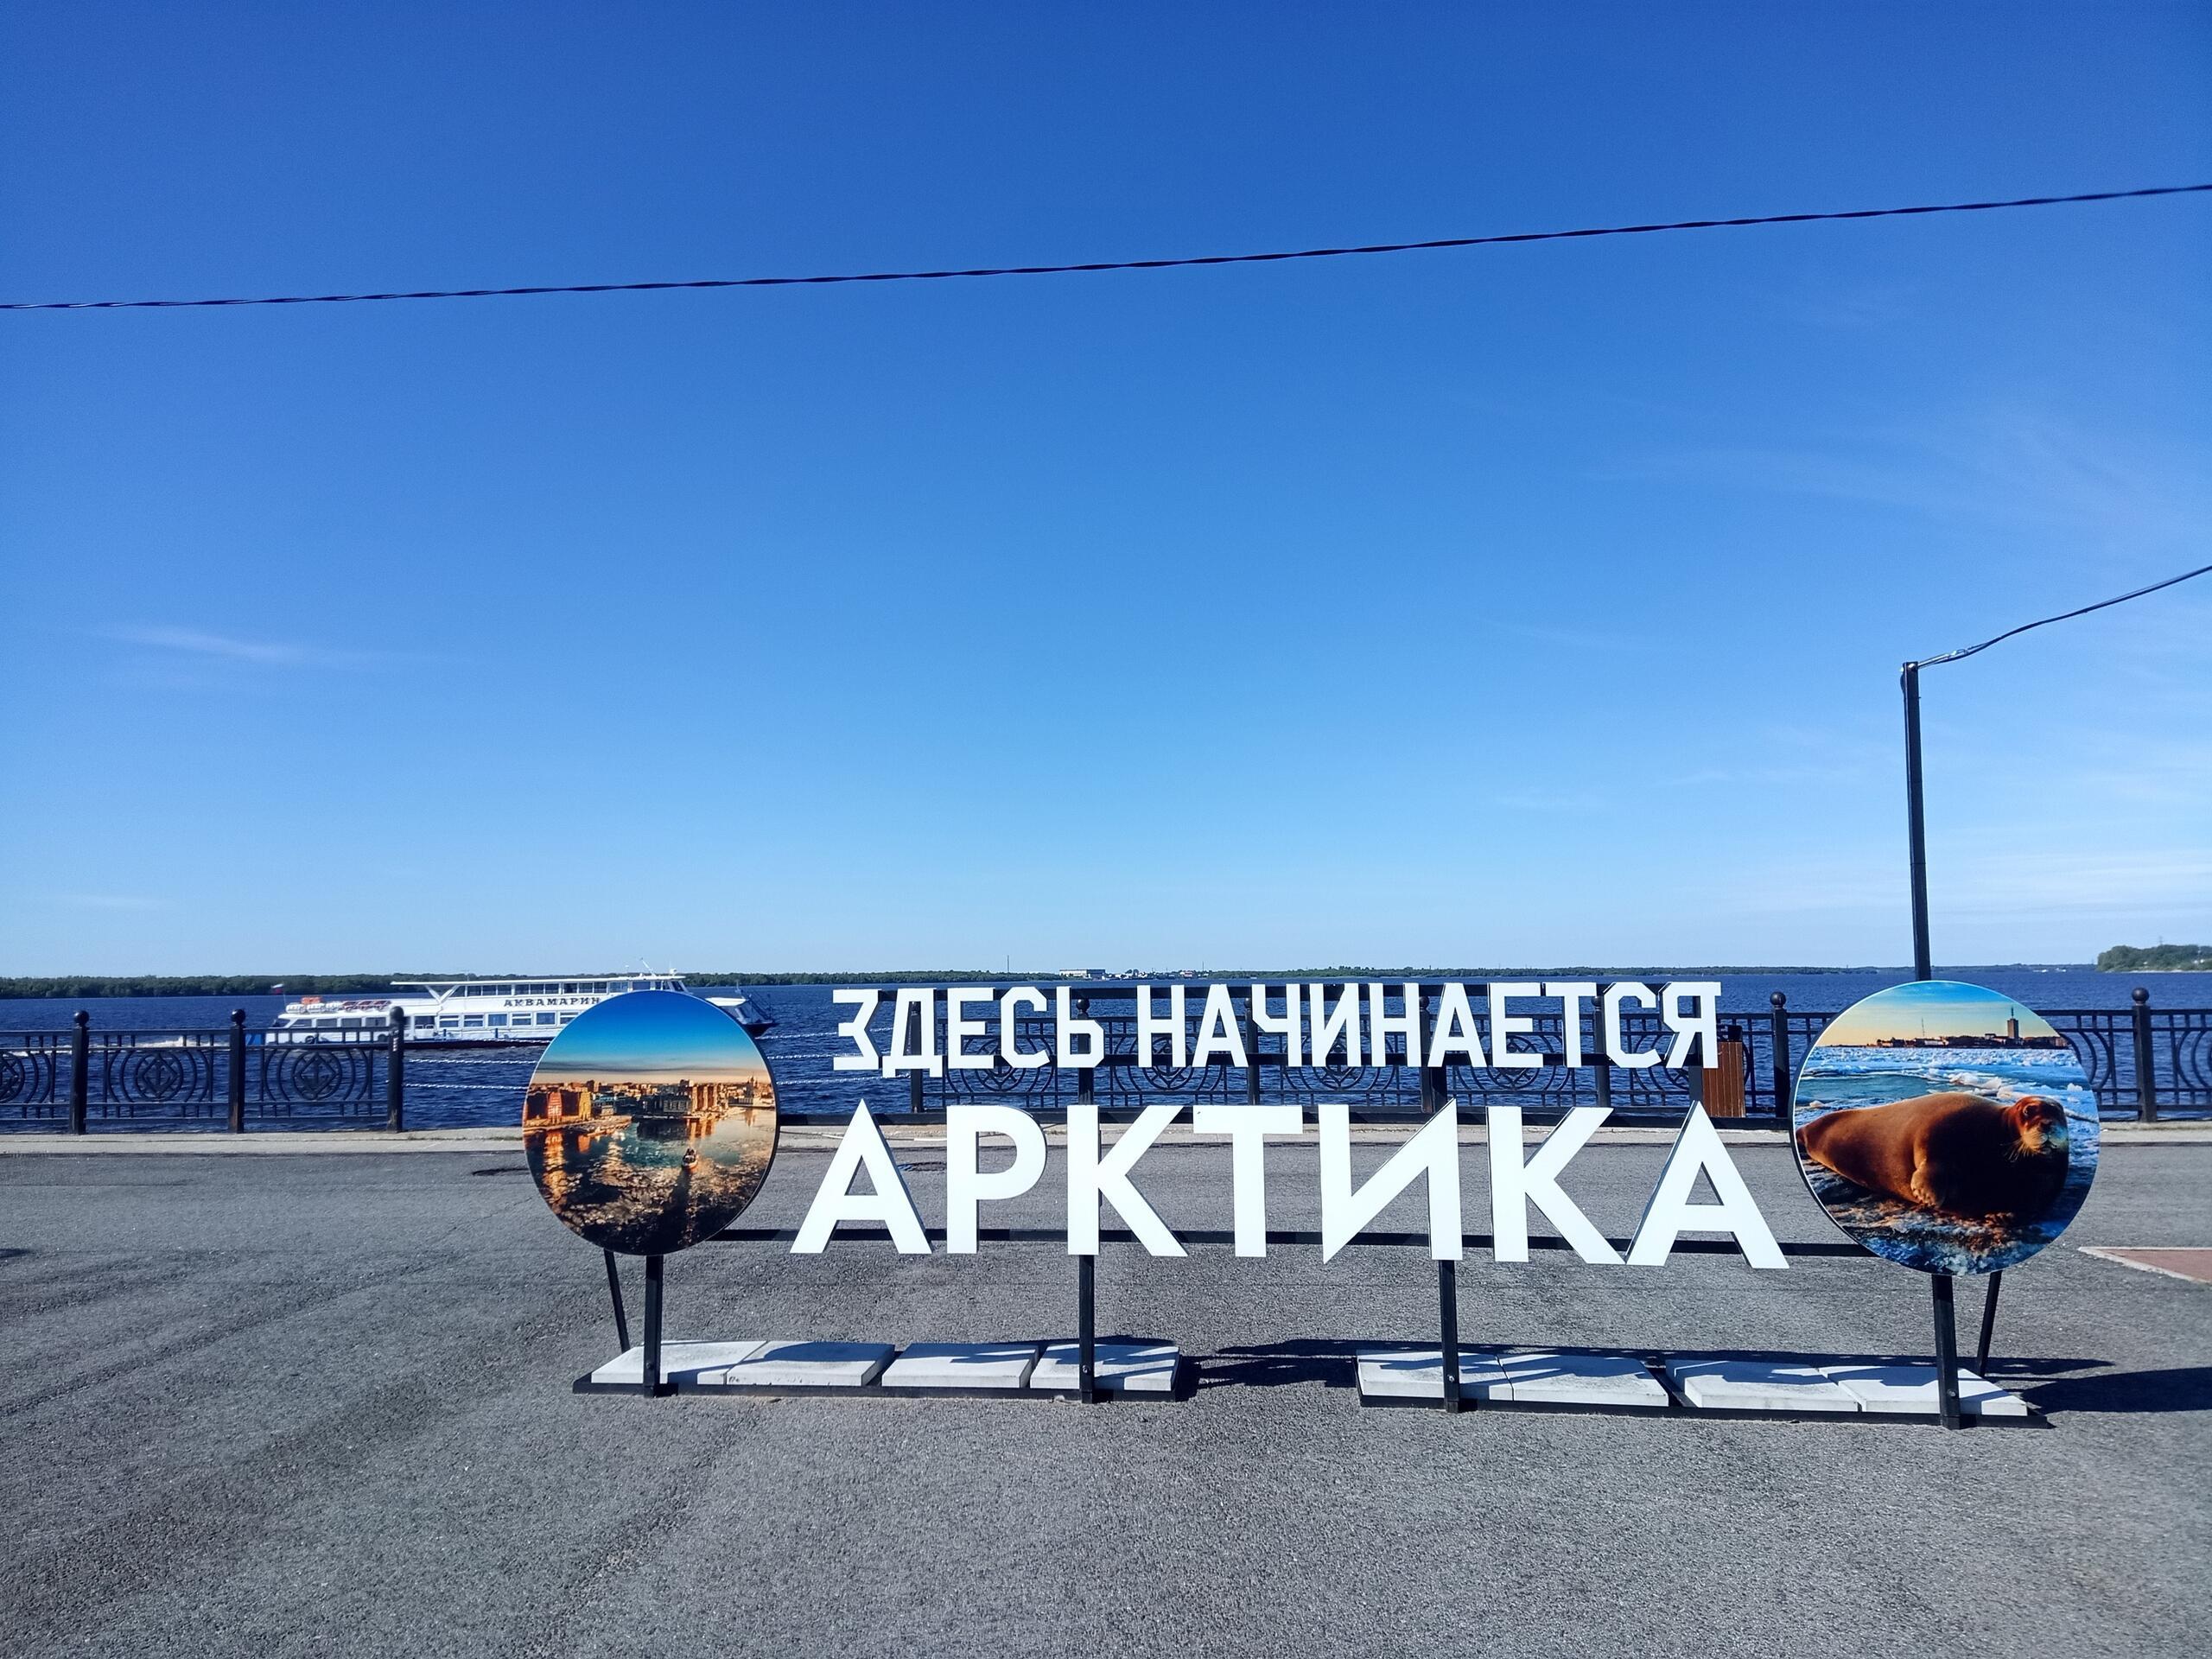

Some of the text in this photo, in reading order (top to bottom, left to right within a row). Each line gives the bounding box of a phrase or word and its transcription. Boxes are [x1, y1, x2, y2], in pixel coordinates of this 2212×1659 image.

[504, 997, 601, 1007] АКВАМАРИН
[832, 982, 1722, 1078] ЗДЕСЬ НАЧИНАЕТСЯ
[789, 1097, 1789, 1269] АРКТИКА
